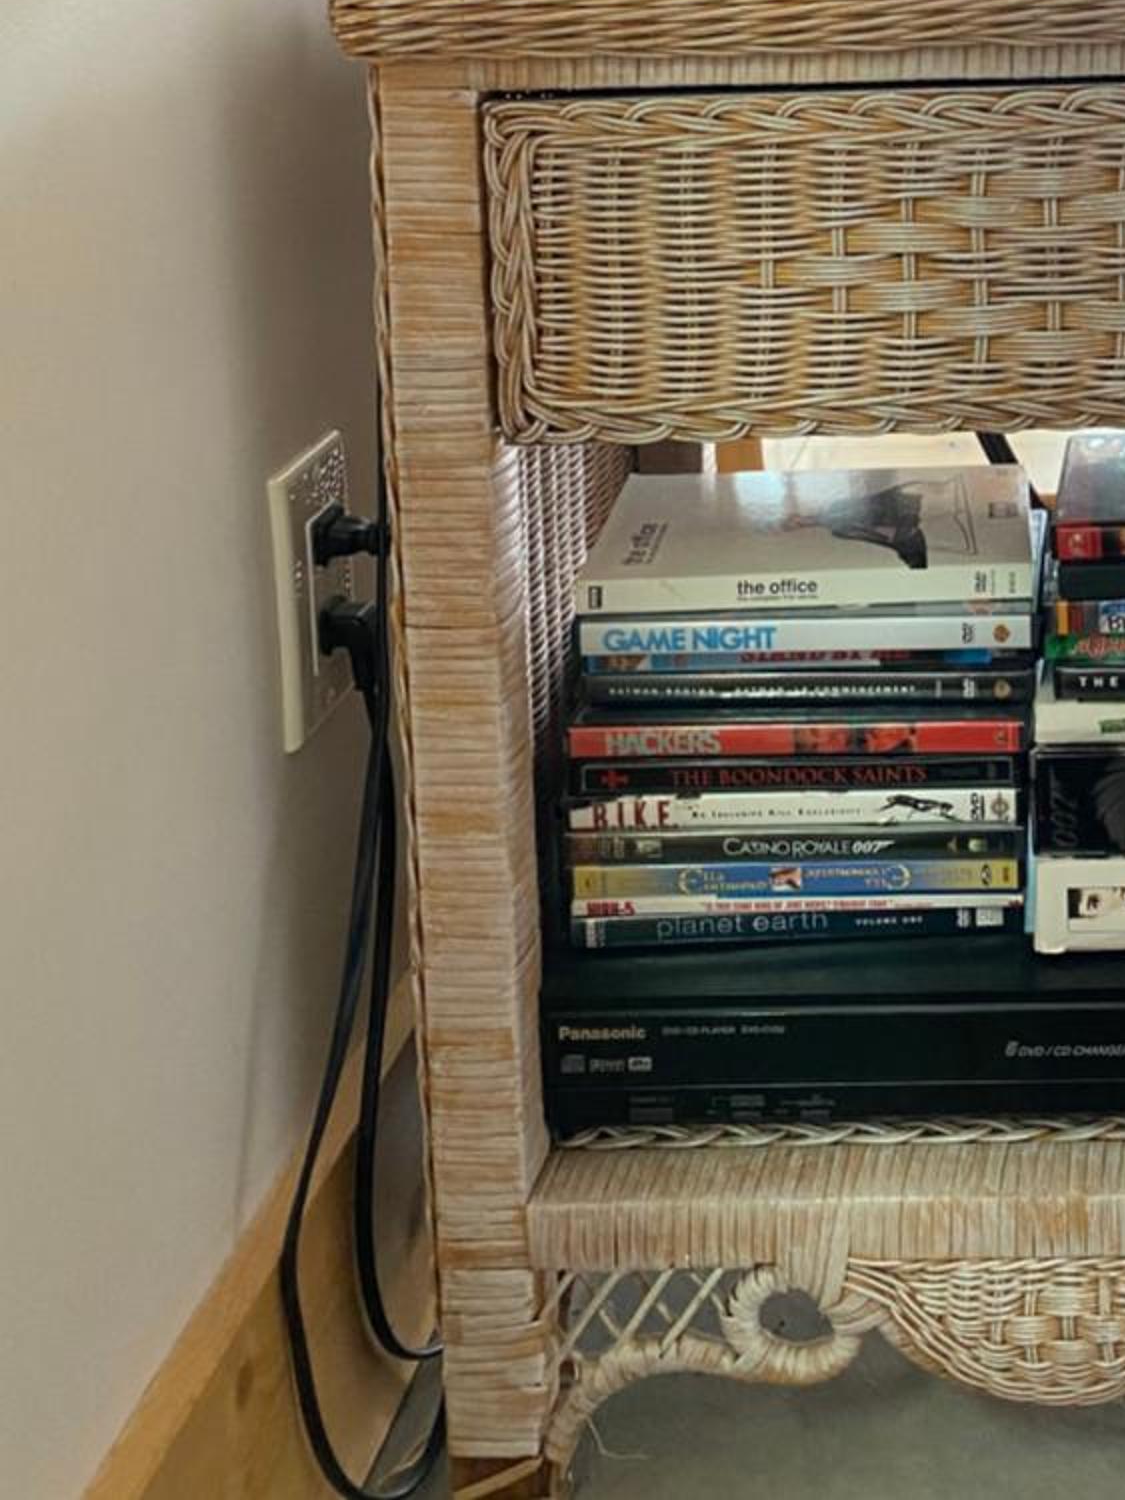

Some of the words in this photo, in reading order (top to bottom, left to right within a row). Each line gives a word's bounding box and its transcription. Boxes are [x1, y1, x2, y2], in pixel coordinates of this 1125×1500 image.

[736, 580, 766, 595] the
[769, 578, 818, 595] office
[603, 628, 686, 651] GAME
[692, 626, 777, 650] NIGHT
[1079, 676, 1119, 688] THE
[605, 729, 722, 755] HACKERS
[673, 770, 709, 786] THE
[719, 768, 846, 785] BOONDOCK
[853, 766, 928, 783] SAINTS
[791, 836, 850, 859] ROYALE
[851, 839, 896, 855] 007
[656, 914, 748, 939] planet
[752, 911, 828, 932] earth
[558, 1024, 647, 1041] Panasonic
